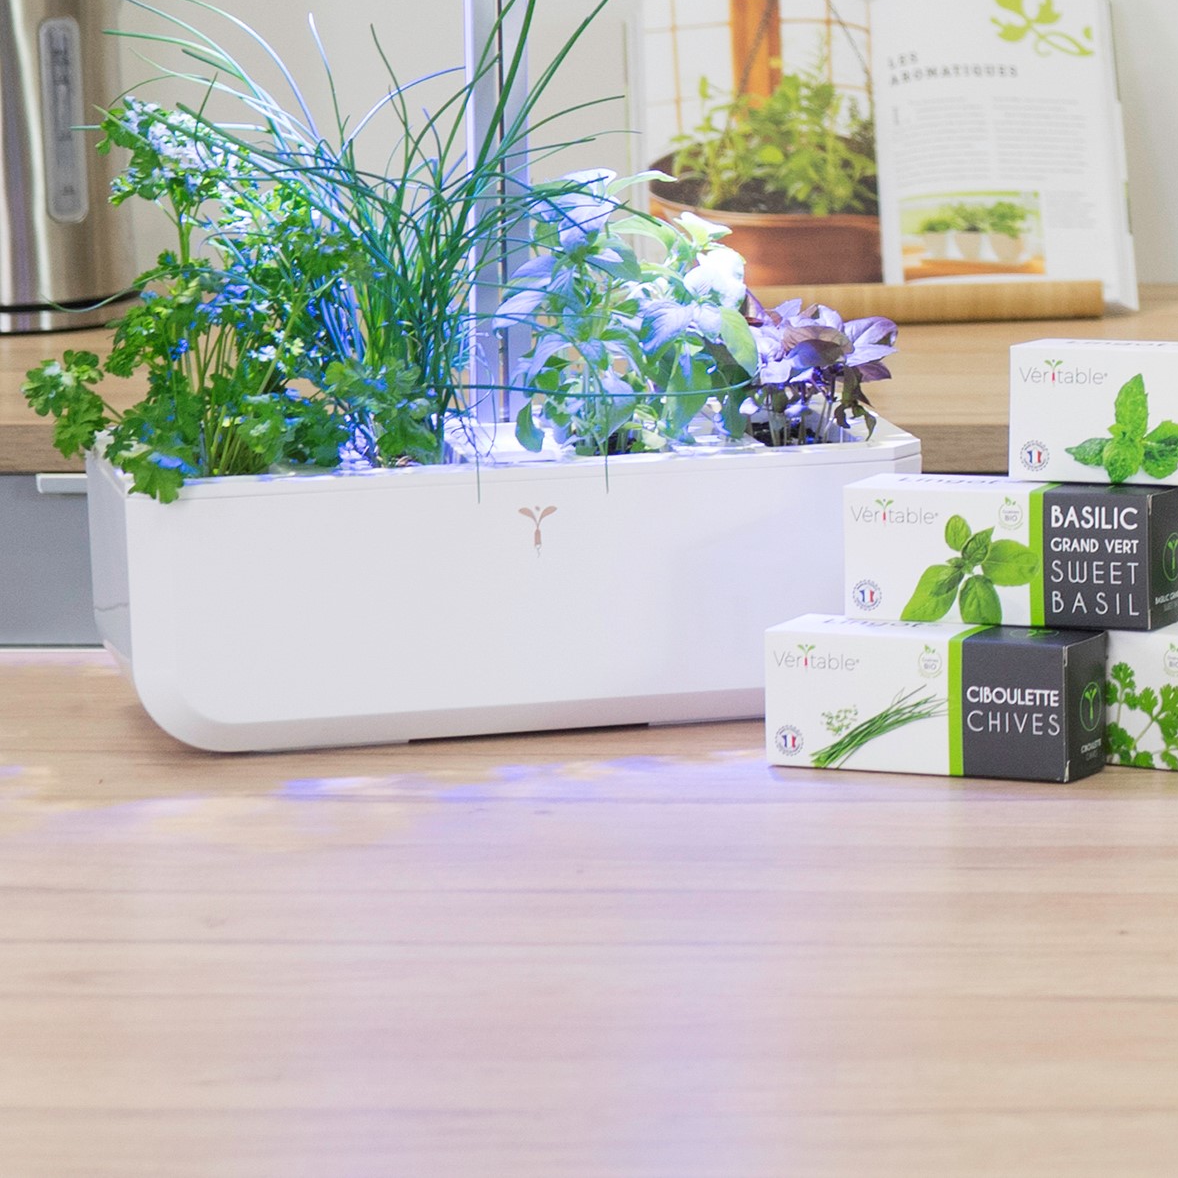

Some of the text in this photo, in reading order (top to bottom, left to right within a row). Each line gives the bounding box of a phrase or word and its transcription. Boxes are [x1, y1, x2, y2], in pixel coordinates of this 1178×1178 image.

[890, 64, 1018, 87] AROMATIQUES
[1052, 506, 1137, 529] BASILIC
[1051, 538, 1138, 553] GRAND VERT
[1051, 560, 1138, 584] SWEET
[1052, 591, 1139, 615] BASIL
[967, 686, 1059, 706] CIBOULETTE
[967, 710, 1060, 735] CHIVES
